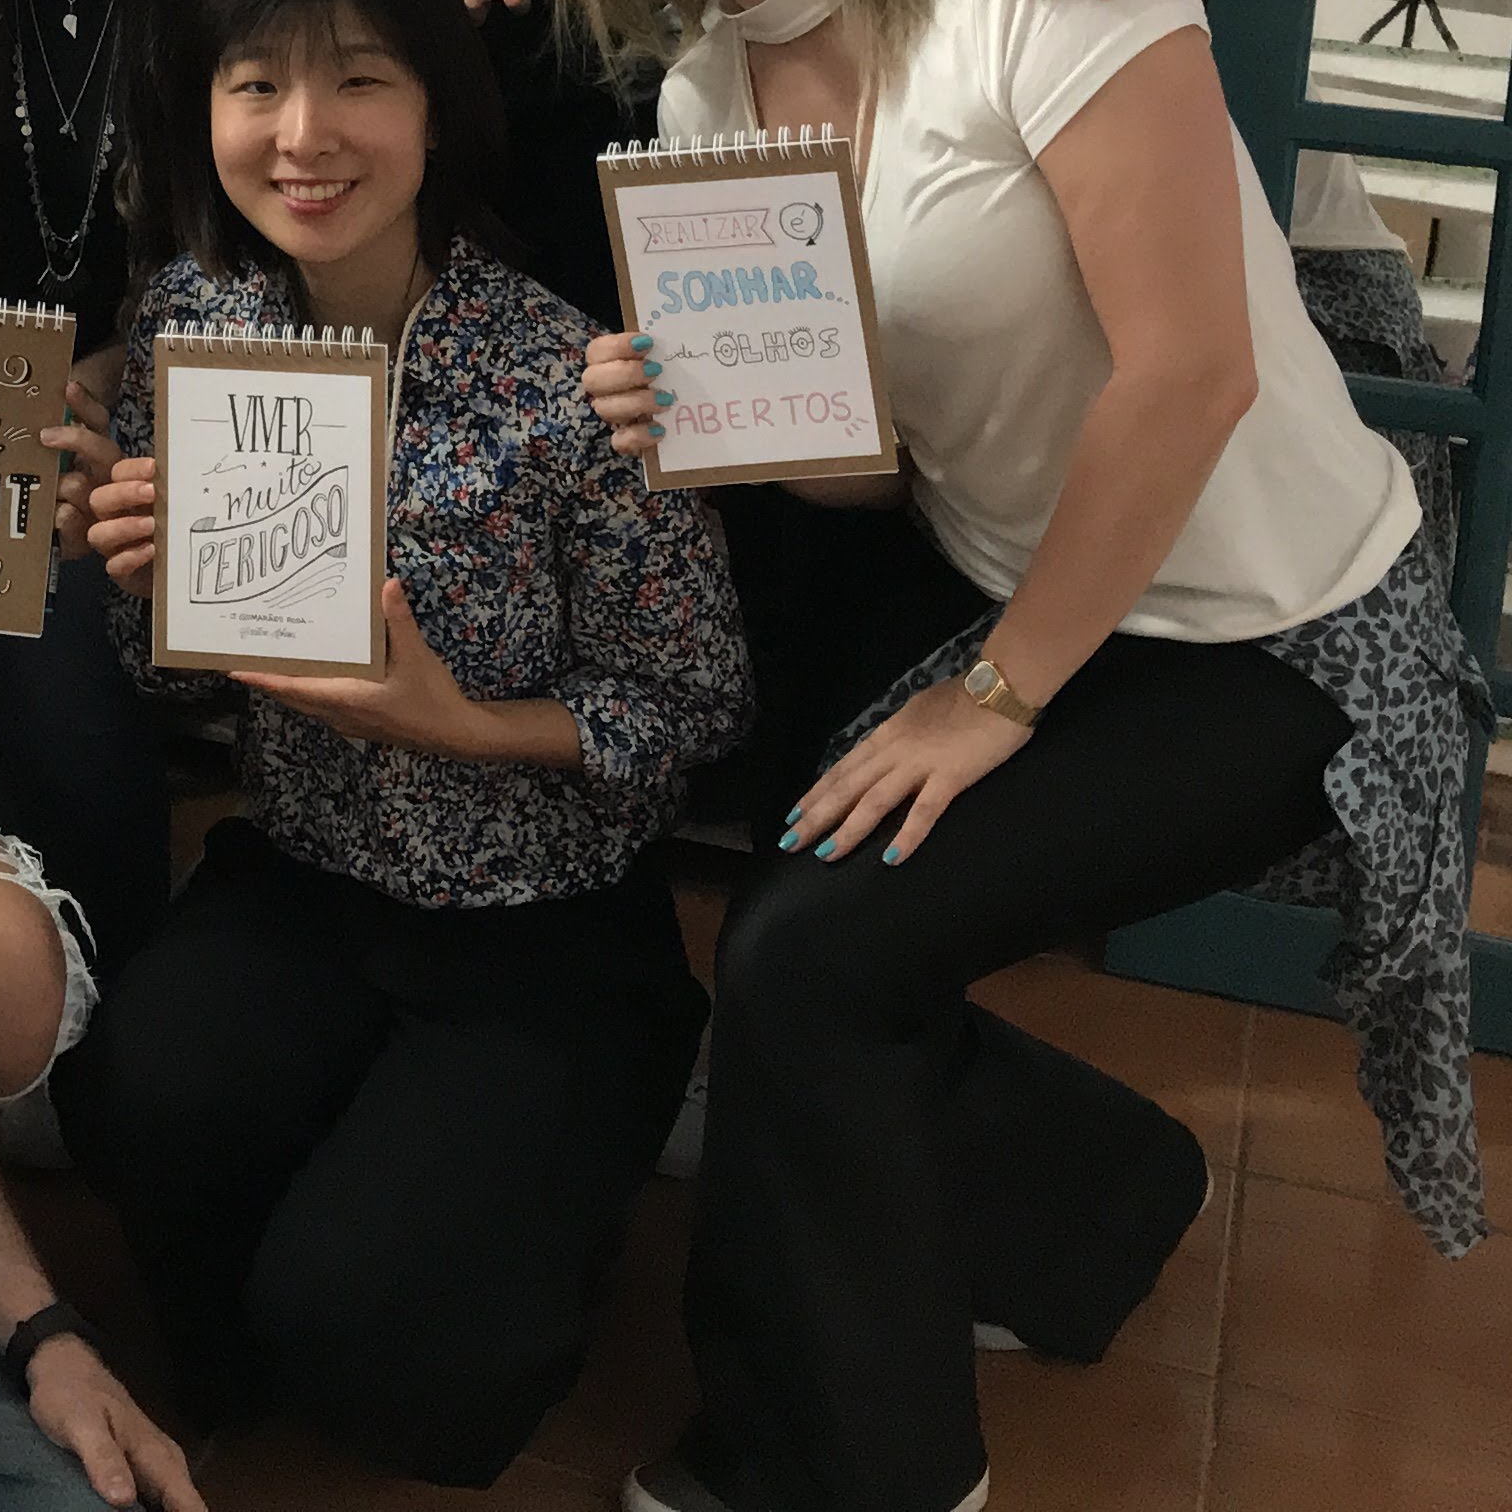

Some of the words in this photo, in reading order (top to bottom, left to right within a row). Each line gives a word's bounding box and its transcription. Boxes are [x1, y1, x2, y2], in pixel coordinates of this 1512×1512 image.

[657, 260, 824, 315] SONHAR
[712, 326, 841, 368] OLHOS
[227, 393, 314, 457] VIVER
[674, 391, 852, 437] ABERTOS
[224, 455, 322, 521] muito
[195, 484, 345, 595] PERIGOSO
